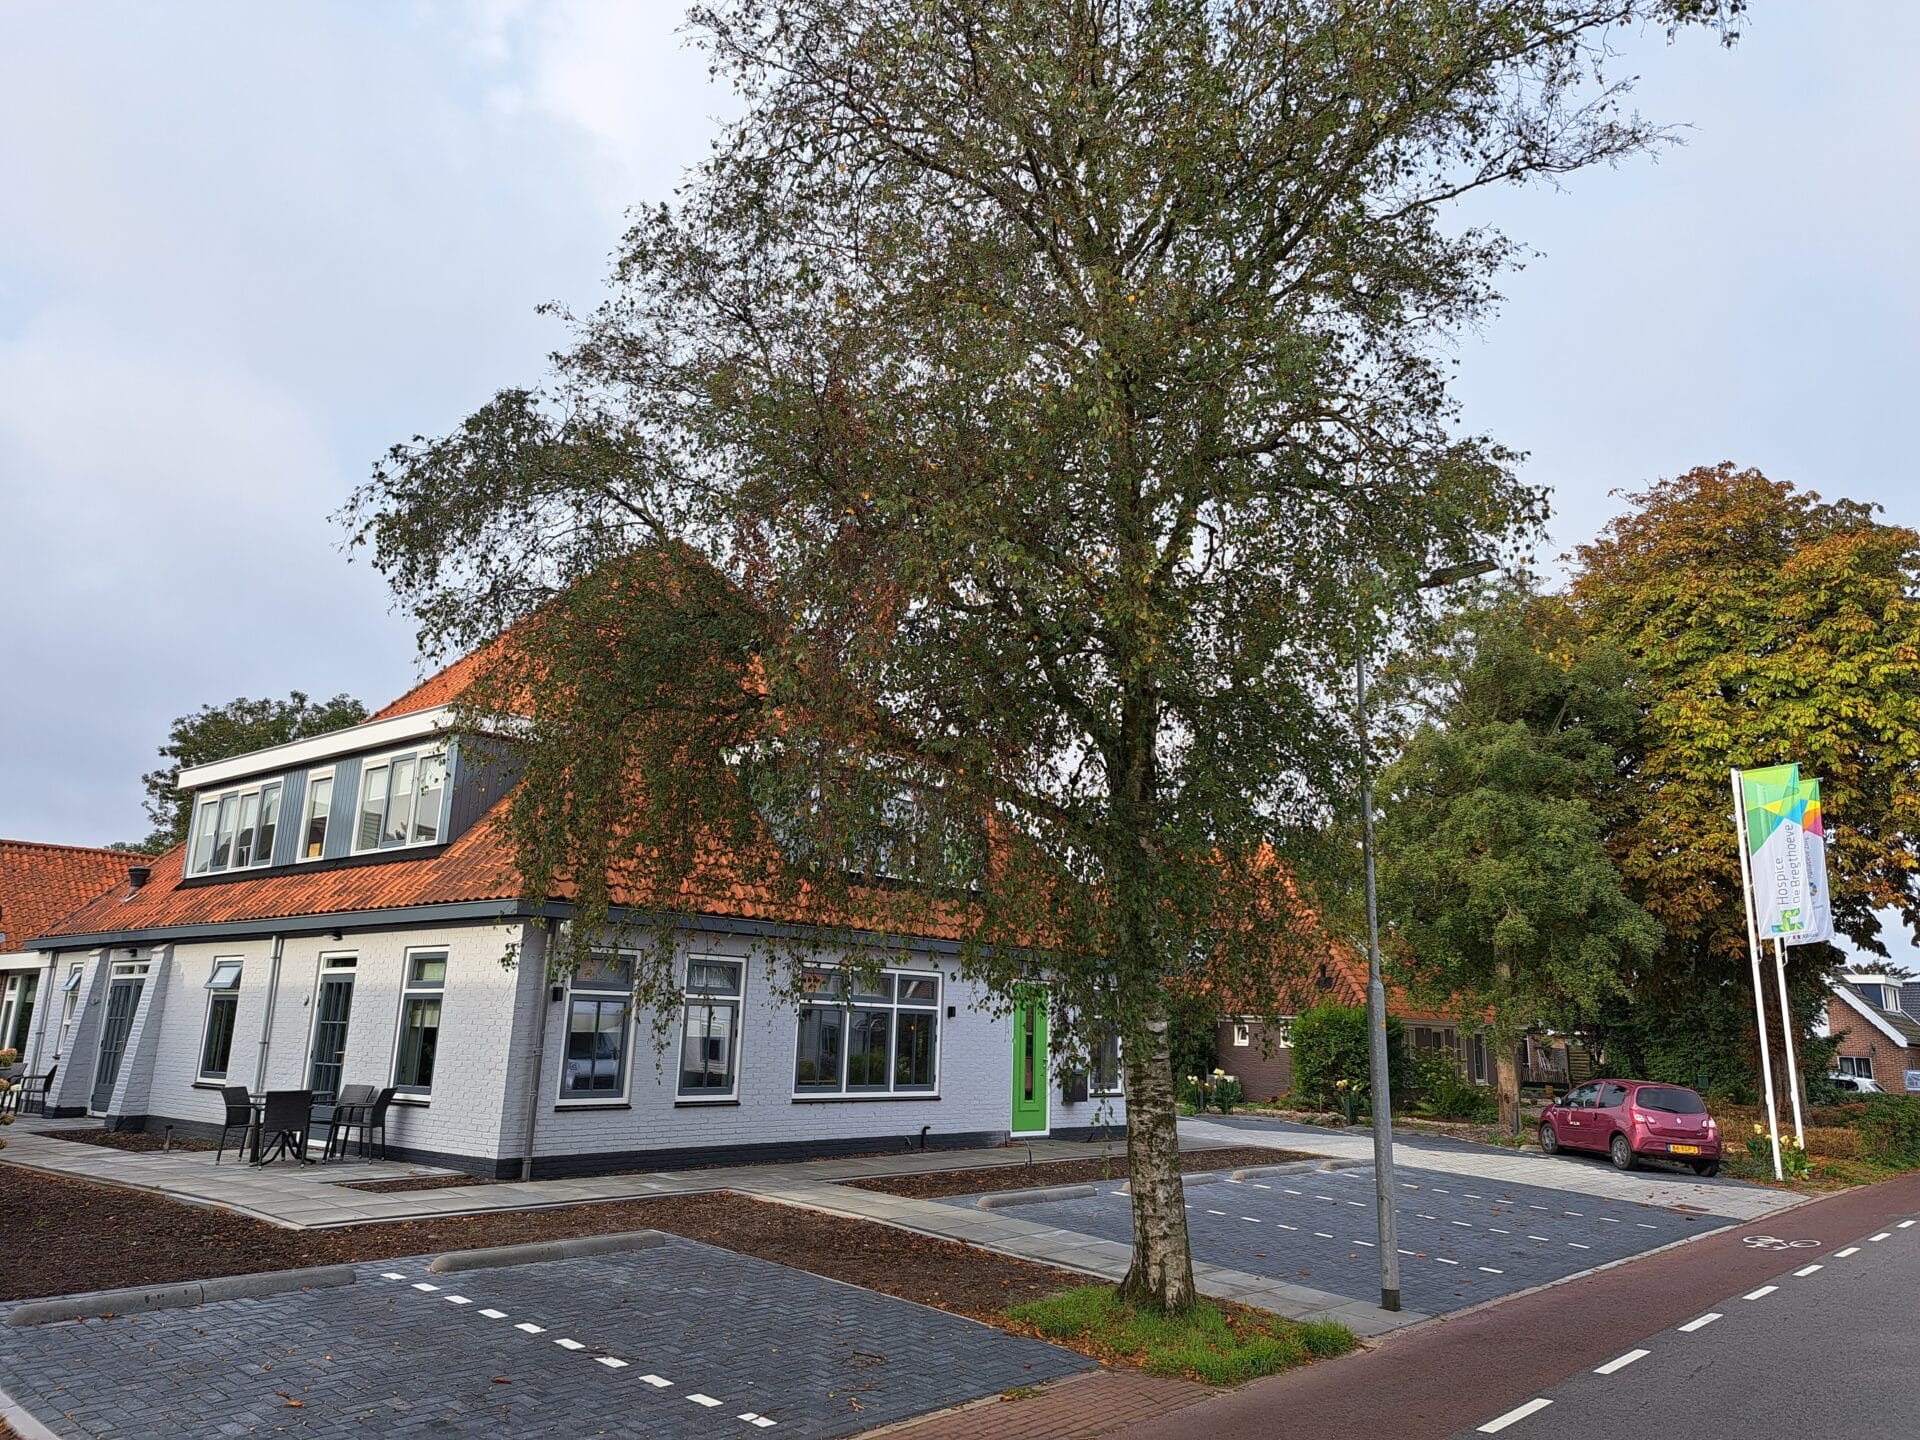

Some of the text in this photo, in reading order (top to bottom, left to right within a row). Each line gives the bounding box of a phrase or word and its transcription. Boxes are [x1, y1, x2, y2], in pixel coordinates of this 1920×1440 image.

[1776, 857, 1789, 905] Hospice
[1784, 824, 1801, 904] De Bregthoeve
